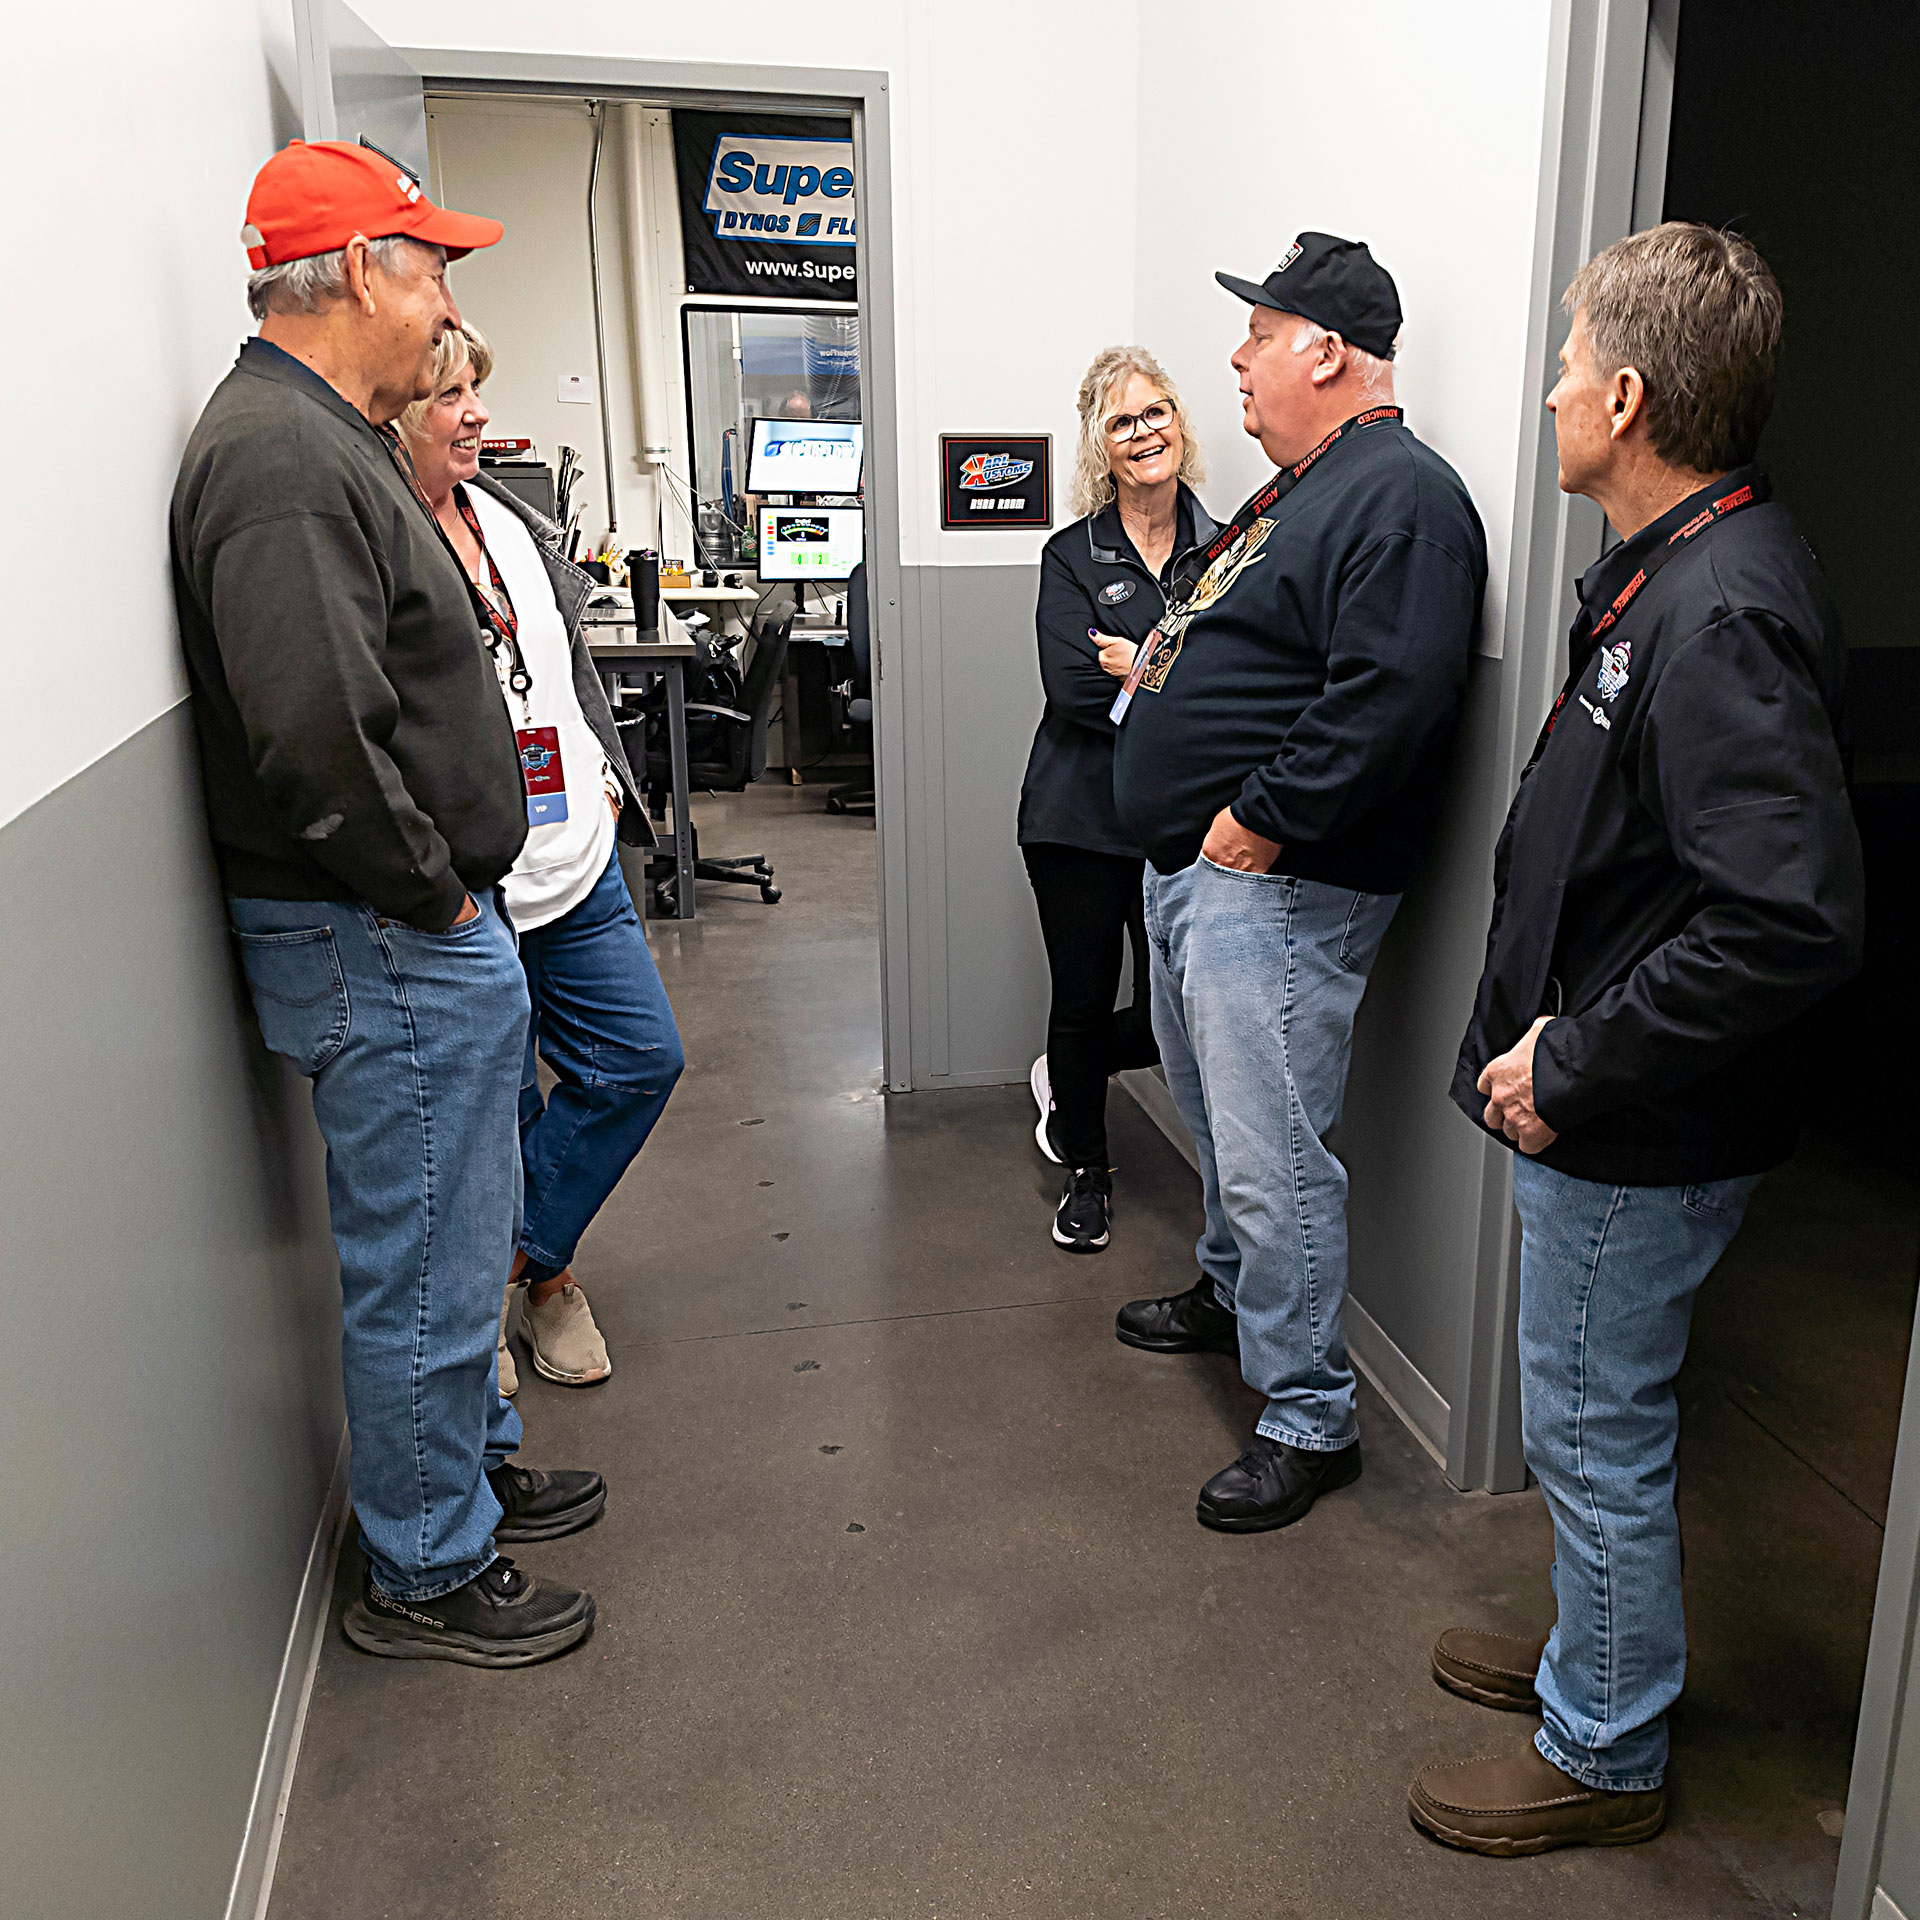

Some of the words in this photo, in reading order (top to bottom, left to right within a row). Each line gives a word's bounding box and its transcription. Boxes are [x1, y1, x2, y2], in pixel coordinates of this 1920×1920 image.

[716, 151, 856, 205] Supe
[723, 211, 791, 233] DYNOS
[745, 260, 856, 282] www.Supe
[1357, 408, 1398, 425] ADVANCED
[1293, 429, 1342, 478] INNOVATIVE
[1253, 487, 1279, 515] AGILE
[1713, 486, 1753, 515] TREMEC
[1207, 524, 1240, 560] CUSTOM
[1111, 590, 1130, 602] PATTY
[1612, 569, 1647, 614] TREMEC
[534, 804, 548, 813] VIP
[370, 1583, 445, 1630] SKECHERS
